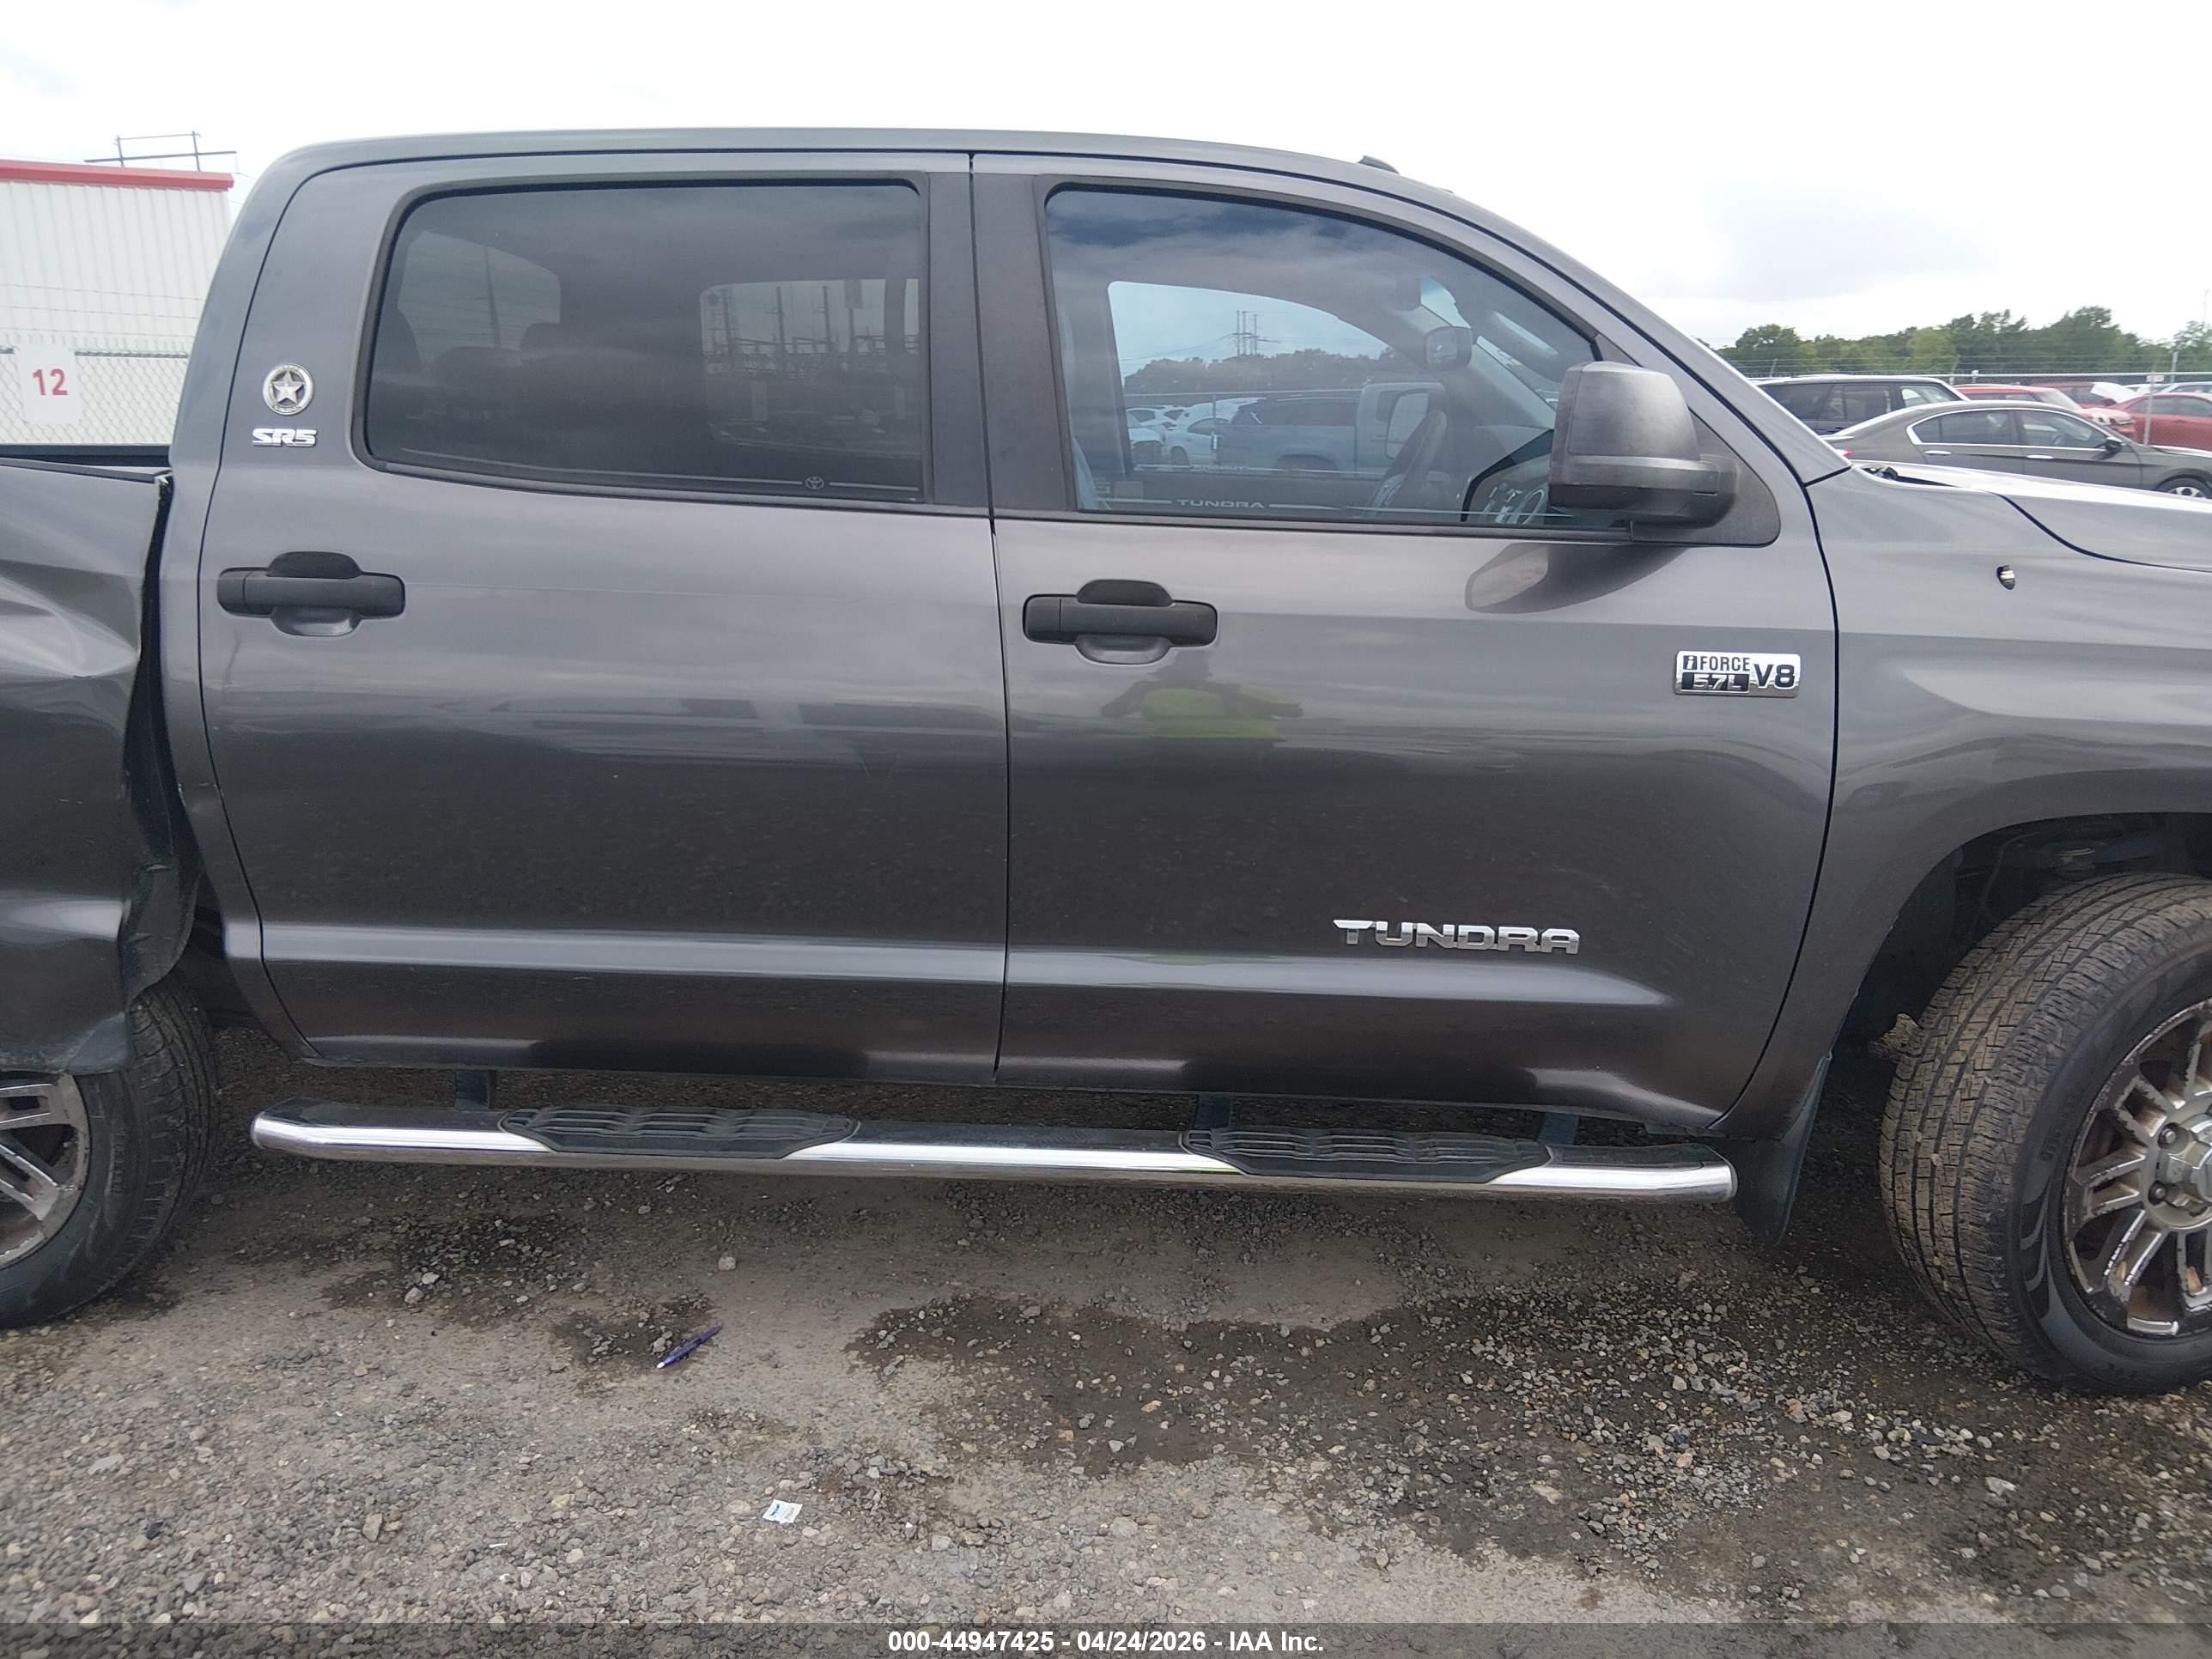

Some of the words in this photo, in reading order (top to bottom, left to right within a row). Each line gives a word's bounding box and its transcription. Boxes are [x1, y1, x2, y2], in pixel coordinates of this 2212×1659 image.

[32, 368, 69, 396] 12
[252, 428, 317, 447] SR5
[1176, 499, 1266, 509] TUNDRA
[1754, 664, 1796, 689] V8
[1333, 919, 1580, 955] TUNDRA
